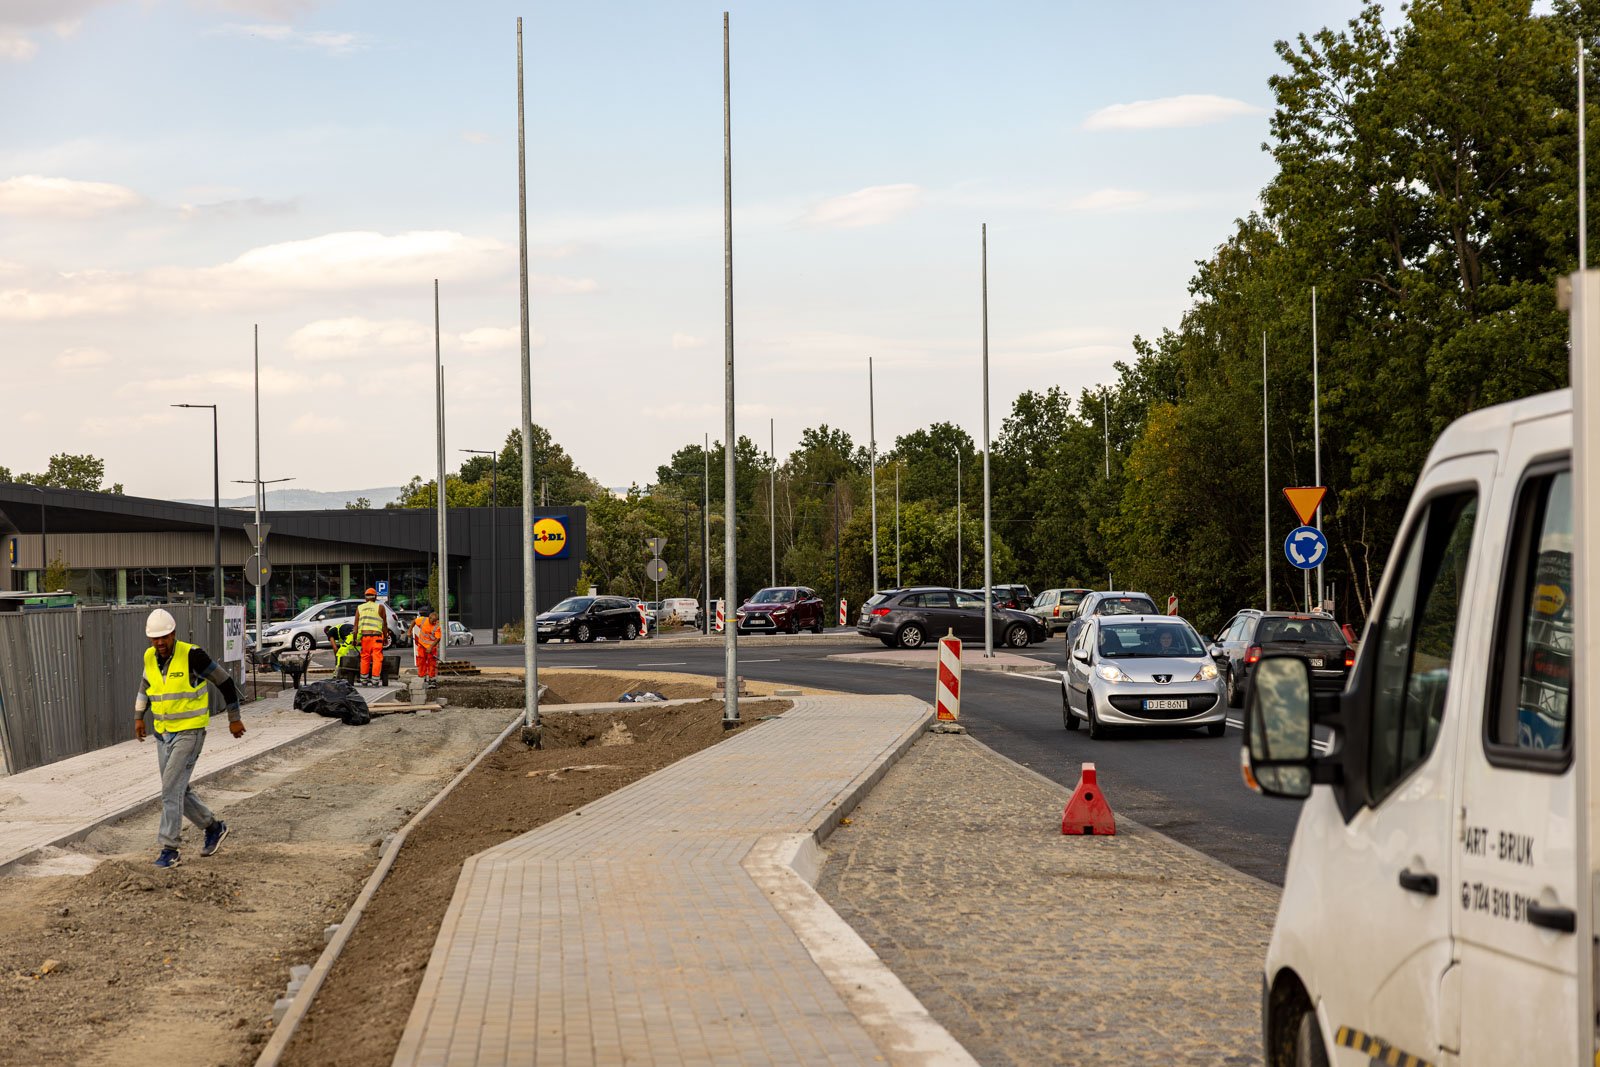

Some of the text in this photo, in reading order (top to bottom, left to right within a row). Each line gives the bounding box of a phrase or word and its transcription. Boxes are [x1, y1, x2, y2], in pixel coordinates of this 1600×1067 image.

[378, 582, 386, 592] P
[1498, 830, 1535, 867] BRUK
[1514, 892, 1531, 923] 91
